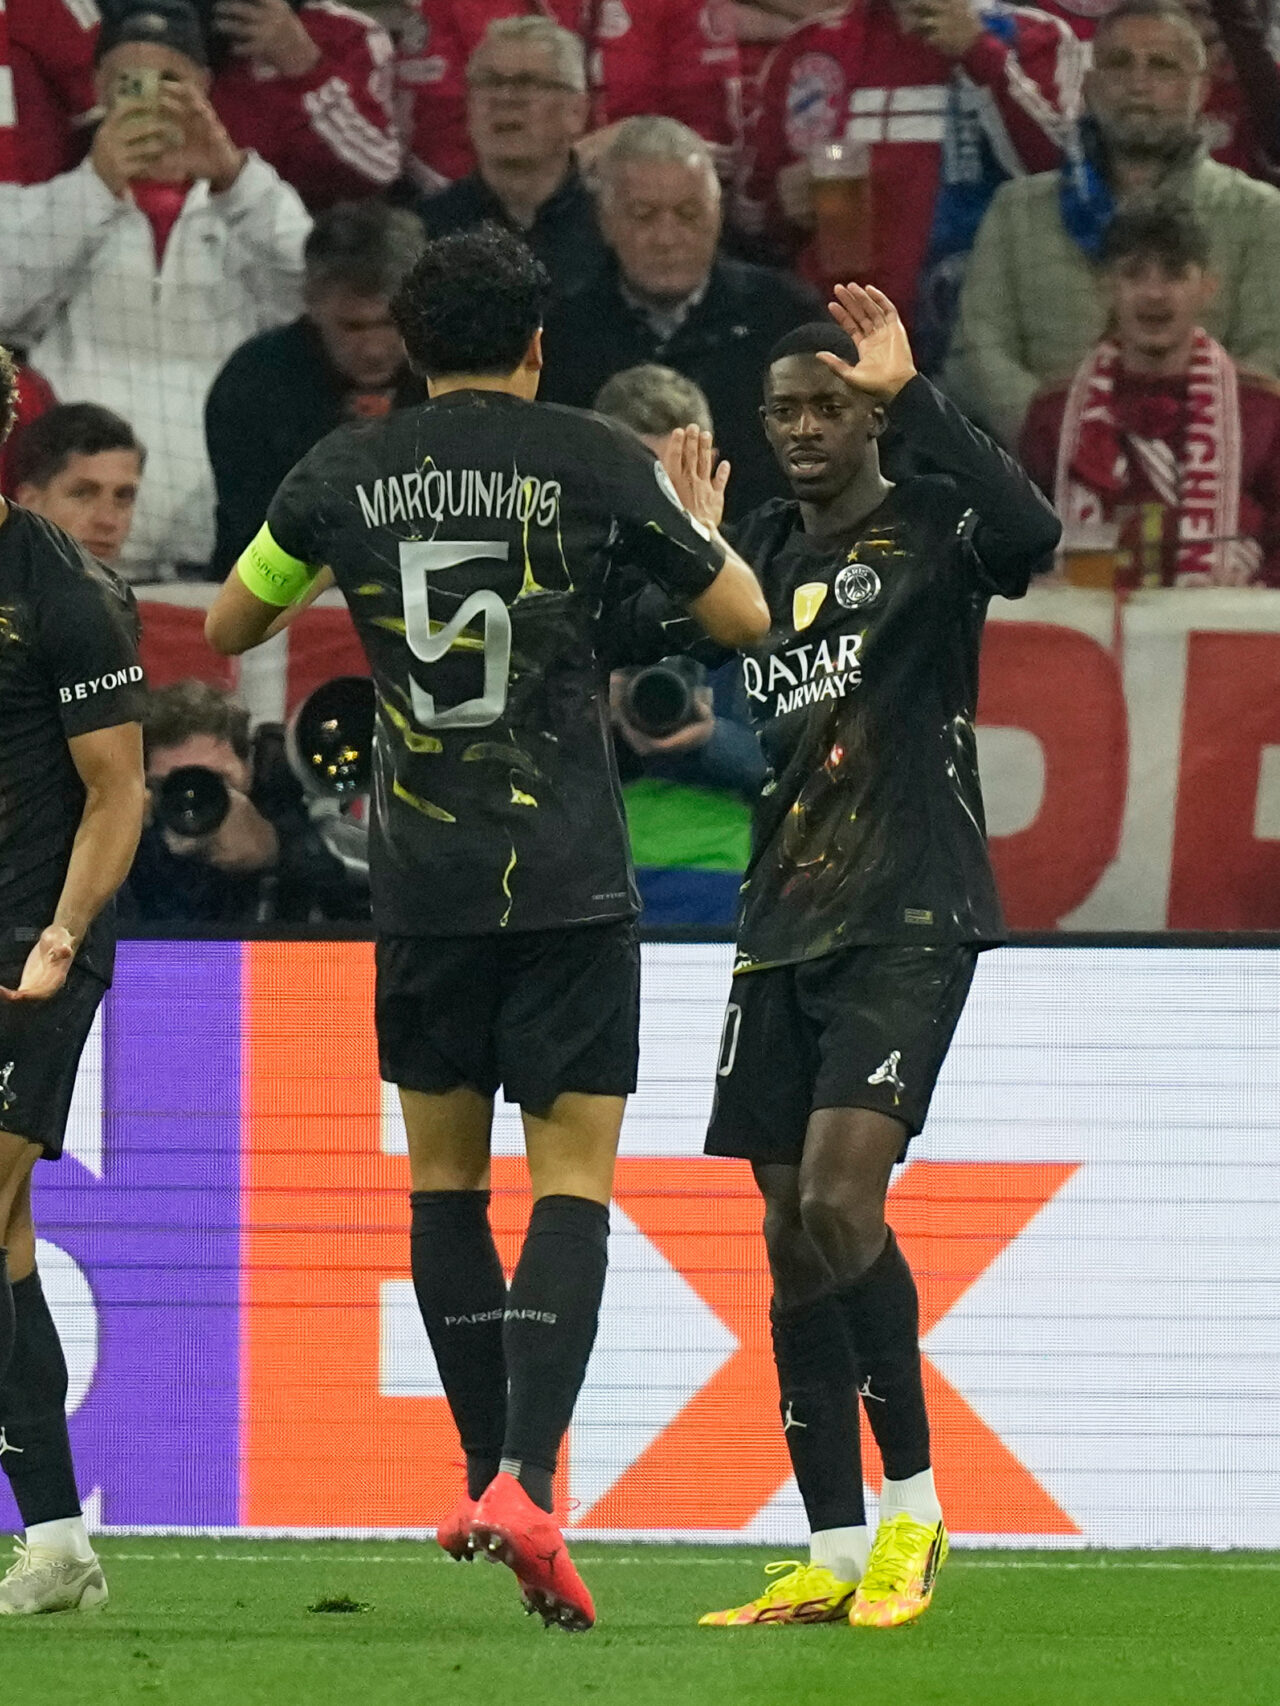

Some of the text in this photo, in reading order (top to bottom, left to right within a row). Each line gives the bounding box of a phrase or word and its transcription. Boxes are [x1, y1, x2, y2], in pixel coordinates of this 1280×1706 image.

[355, 470, 561, 528] MARQUINHOS
[399, 541, 511, 729] 5
[59, 665, 144, 704] BEYOND
[743, 635, 863, 703] QATAR
[775, 670, 863, 717] AIRWAYS
